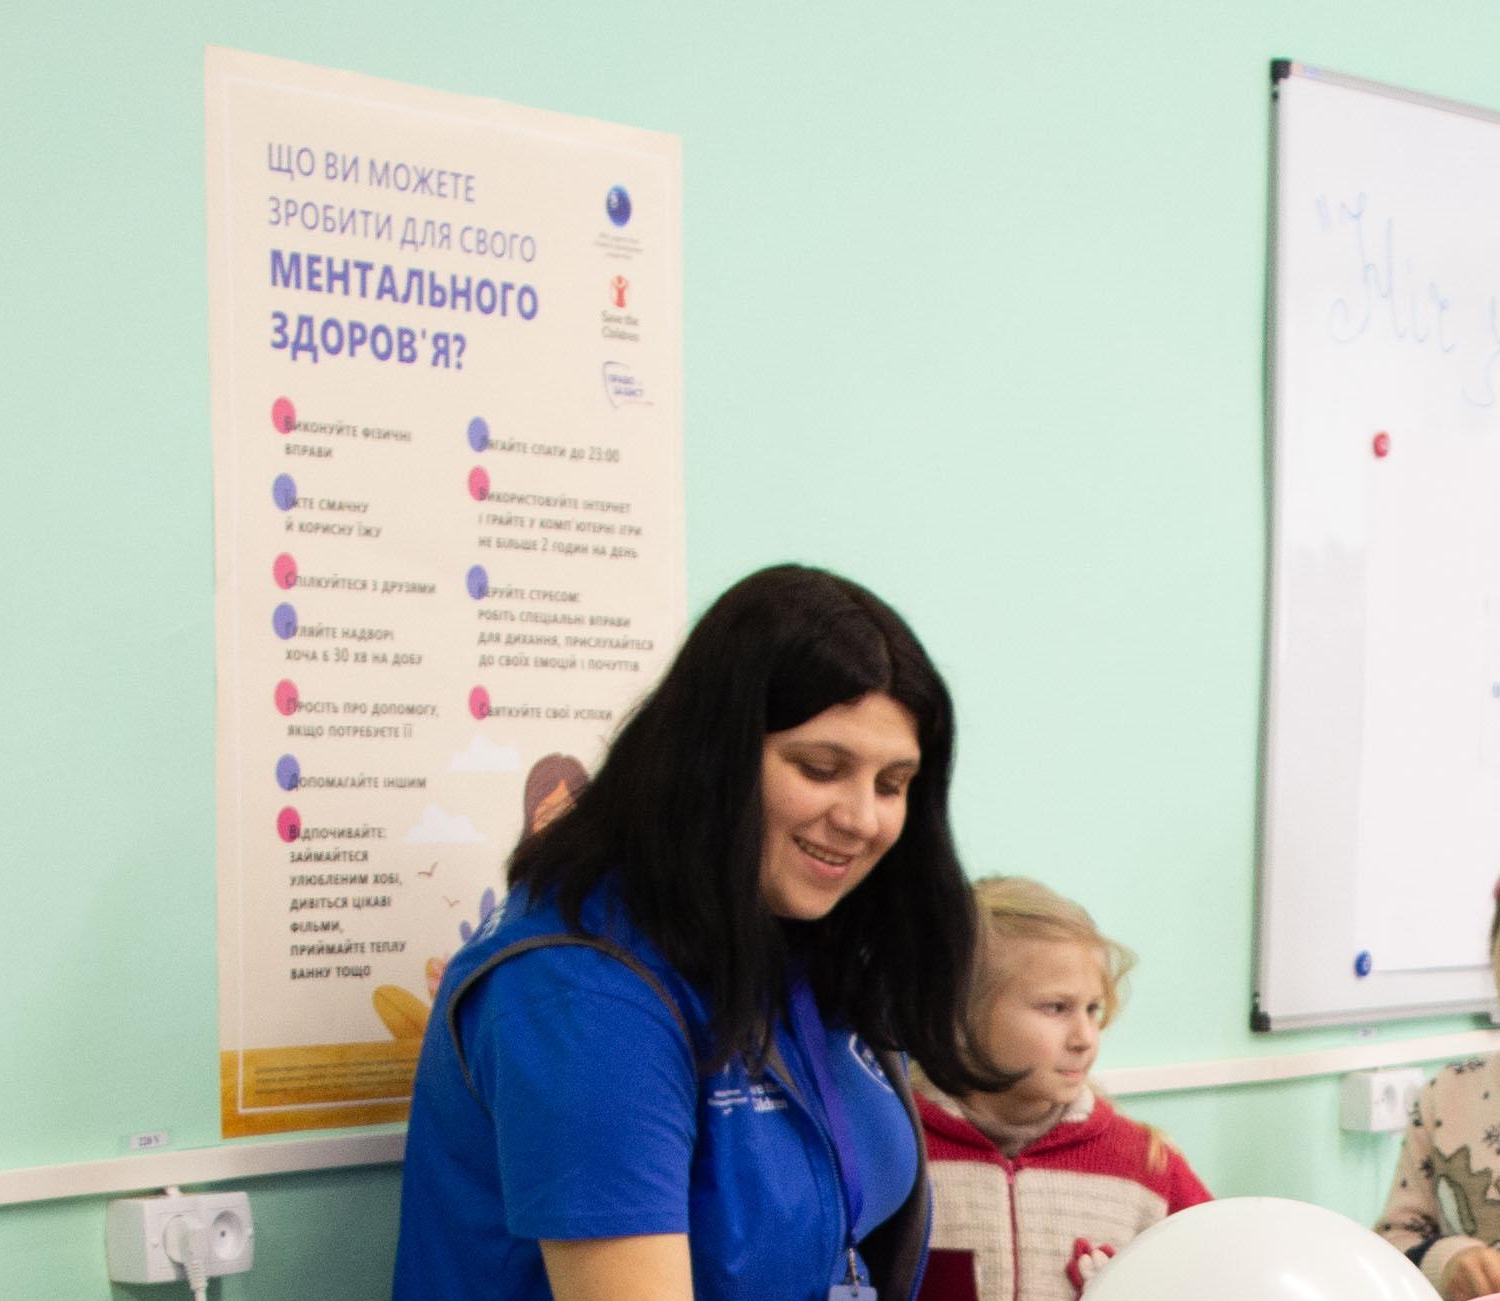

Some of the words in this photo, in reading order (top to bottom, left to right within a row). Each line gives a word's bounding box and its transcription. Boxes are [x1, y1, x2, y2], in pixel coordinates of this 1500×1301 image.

[268, 142, 315, 181] ЩО
[324, 151, 359, 183] ВИ
[368, 158, 476, 203] МОЖЕТЕ
[268, 195, 393, 242] ЗРОБИТИ
[400, 216, 451, 252] ДЛЯ
[459, 225, 537, 263] СВОГО
[269, 248, 539, 321] МЕНТАЛЬНОГО
[270, 310, 467, 370] ЗДОРОВ'Я?
